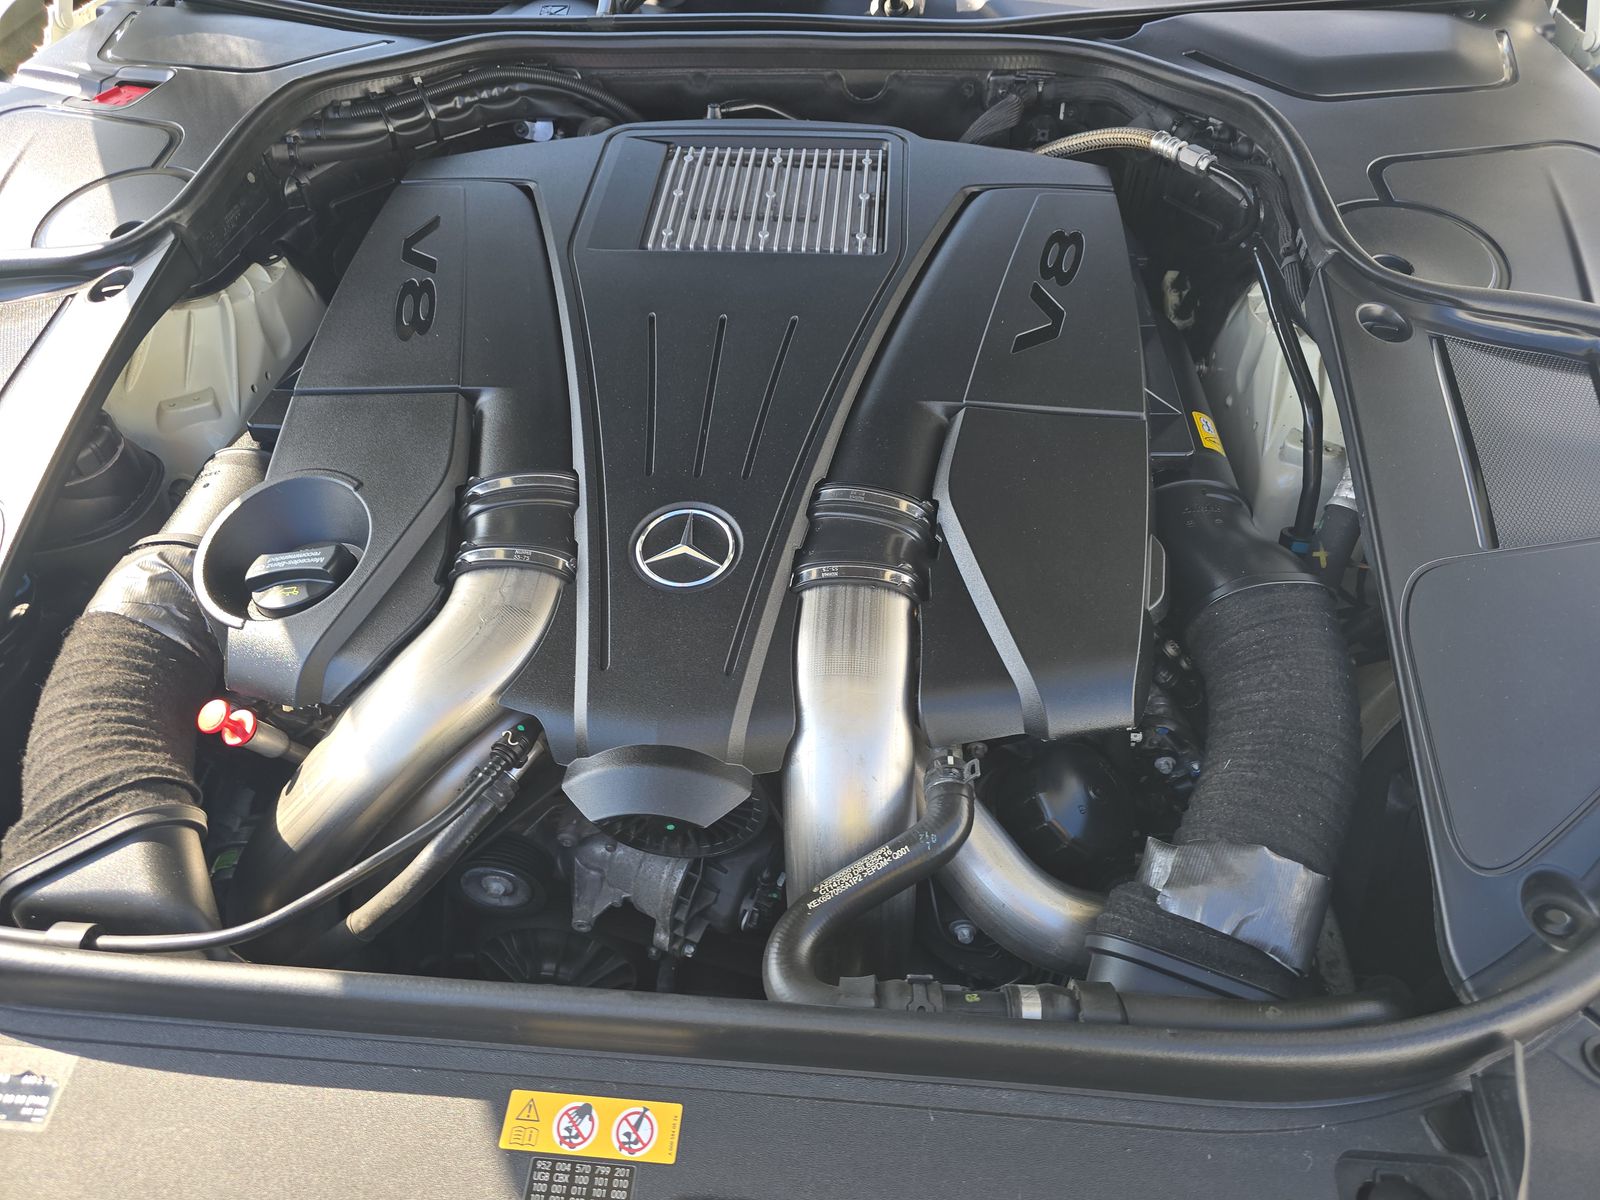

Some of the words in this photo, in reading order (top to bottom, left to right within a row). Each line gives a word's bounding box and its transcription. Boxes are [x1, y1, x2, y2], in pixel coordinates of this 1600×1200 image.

[395, 214, 440, 342] V8
[1010, 228, 1086, 354] V8
[536, 1160, 552, 1171] 952
[555, 1162, 571, 1172] 004
[575, 1164, 591, 1174] 570
[594, 1165, 611, 1175] 799
[614, 1167, 630, 1177] 201
[532, 1182, 548, 1193] 100
[551, 1184, 567, 1194] 001
[570, 1186, 587, 1196] 011
[592, 1188, 607, 1198] 101
[610, 1190, 627, 1200] 000
[574, 1175, 590, 1185] 100
[594, 1177, 608, 1187] 101
[612, 1178, 629, 1189] 010
